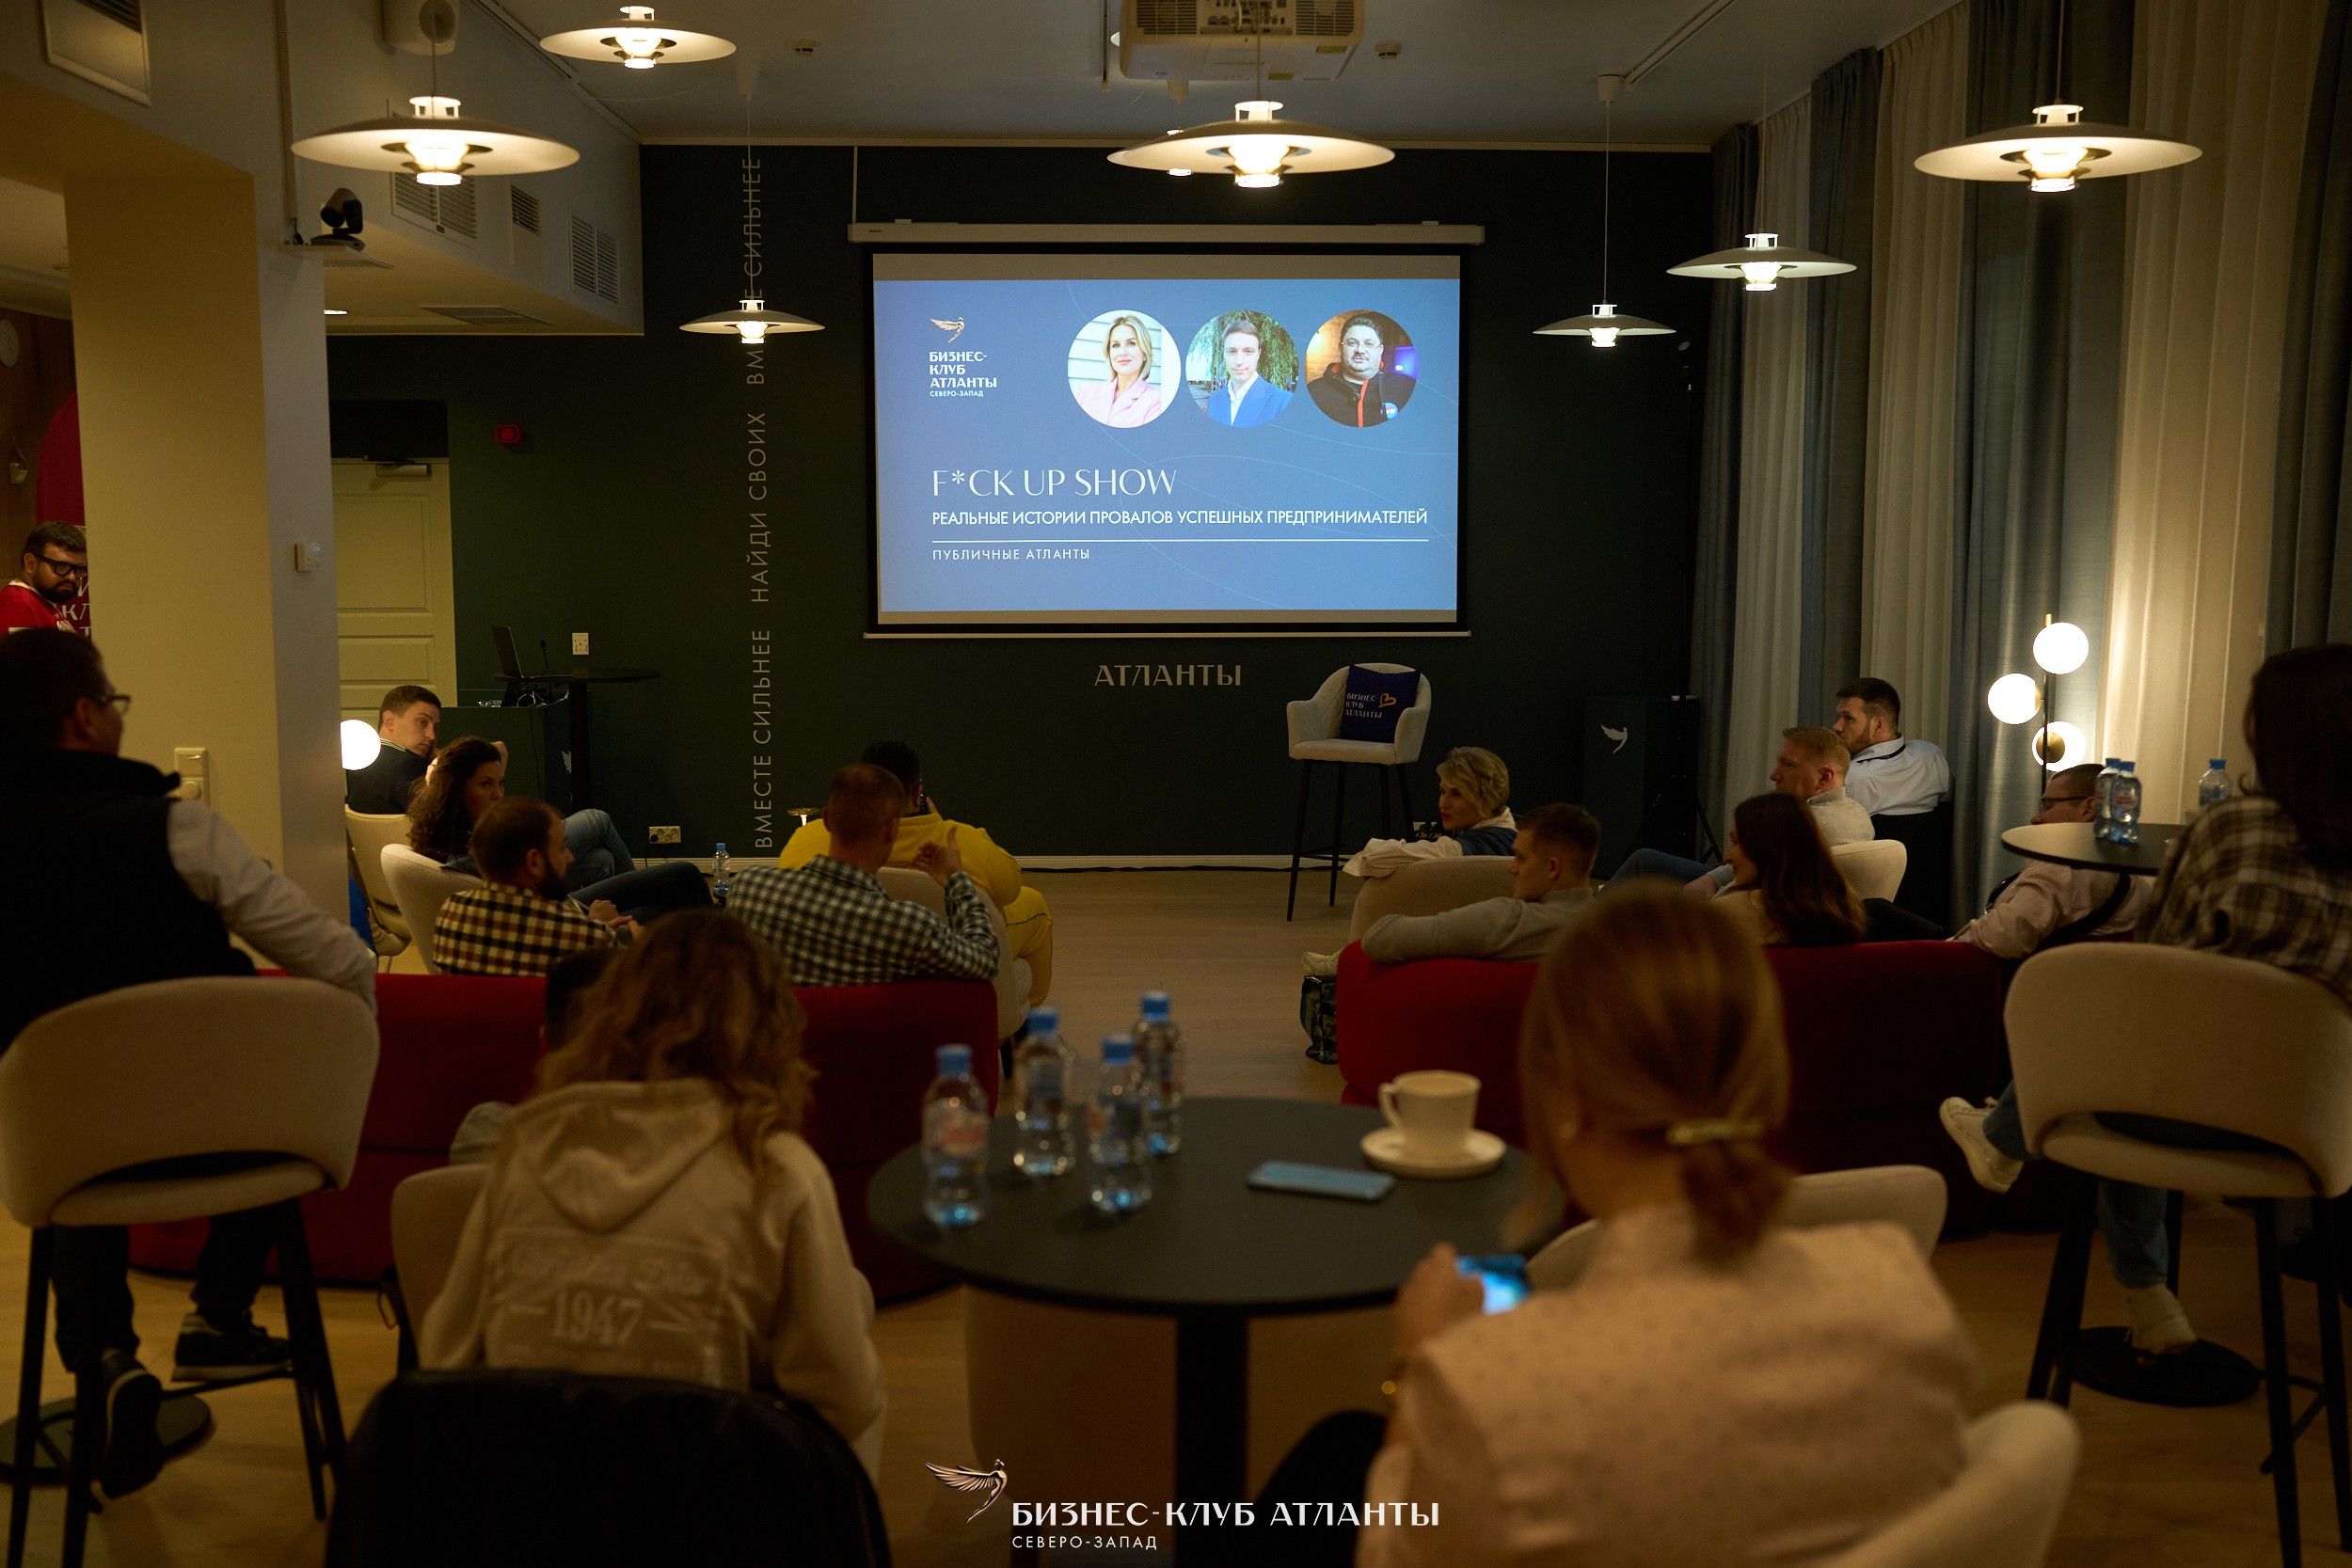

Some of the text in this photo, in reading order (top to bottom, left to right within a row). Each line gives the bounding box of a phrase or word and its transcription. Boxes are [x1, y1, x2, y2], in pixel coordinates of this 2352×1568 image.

[929, 351, 987, 362] БИЗНЕС-
[929, 364, 966, 375] КЛУБ
[930, 377, 997, 388] АТЛАНТЫ
[1024, 469, 1066, 496] UP
[1074, 469, 1177, 496] SHOW
[742, 158, 772, 847] ВМЕСТЕ СИЛЬНЕЕ НАЙДИ СВОИХ ВМЕ СИЛЬНЕЕ
[932, 508, 1428, 526] РЕАЛЬНЫЕ ИСТОРИИ ПРОВАЛОВ УСПЕШНЫХ ПРЕДПРИНИМАТЕЛЕЙ
[932, 548, 1089, 561] ПУБЛИЧНЫЕ АТЛАНТЫ
[1094, 664, 1241, 687] АТЛАНТЫ
[1345, 701, 1364, 709] КЛУБ
[1344, 708, 1382, 719] АТЛАНТЫ
[551, 1290, 645, 1346] 1947
